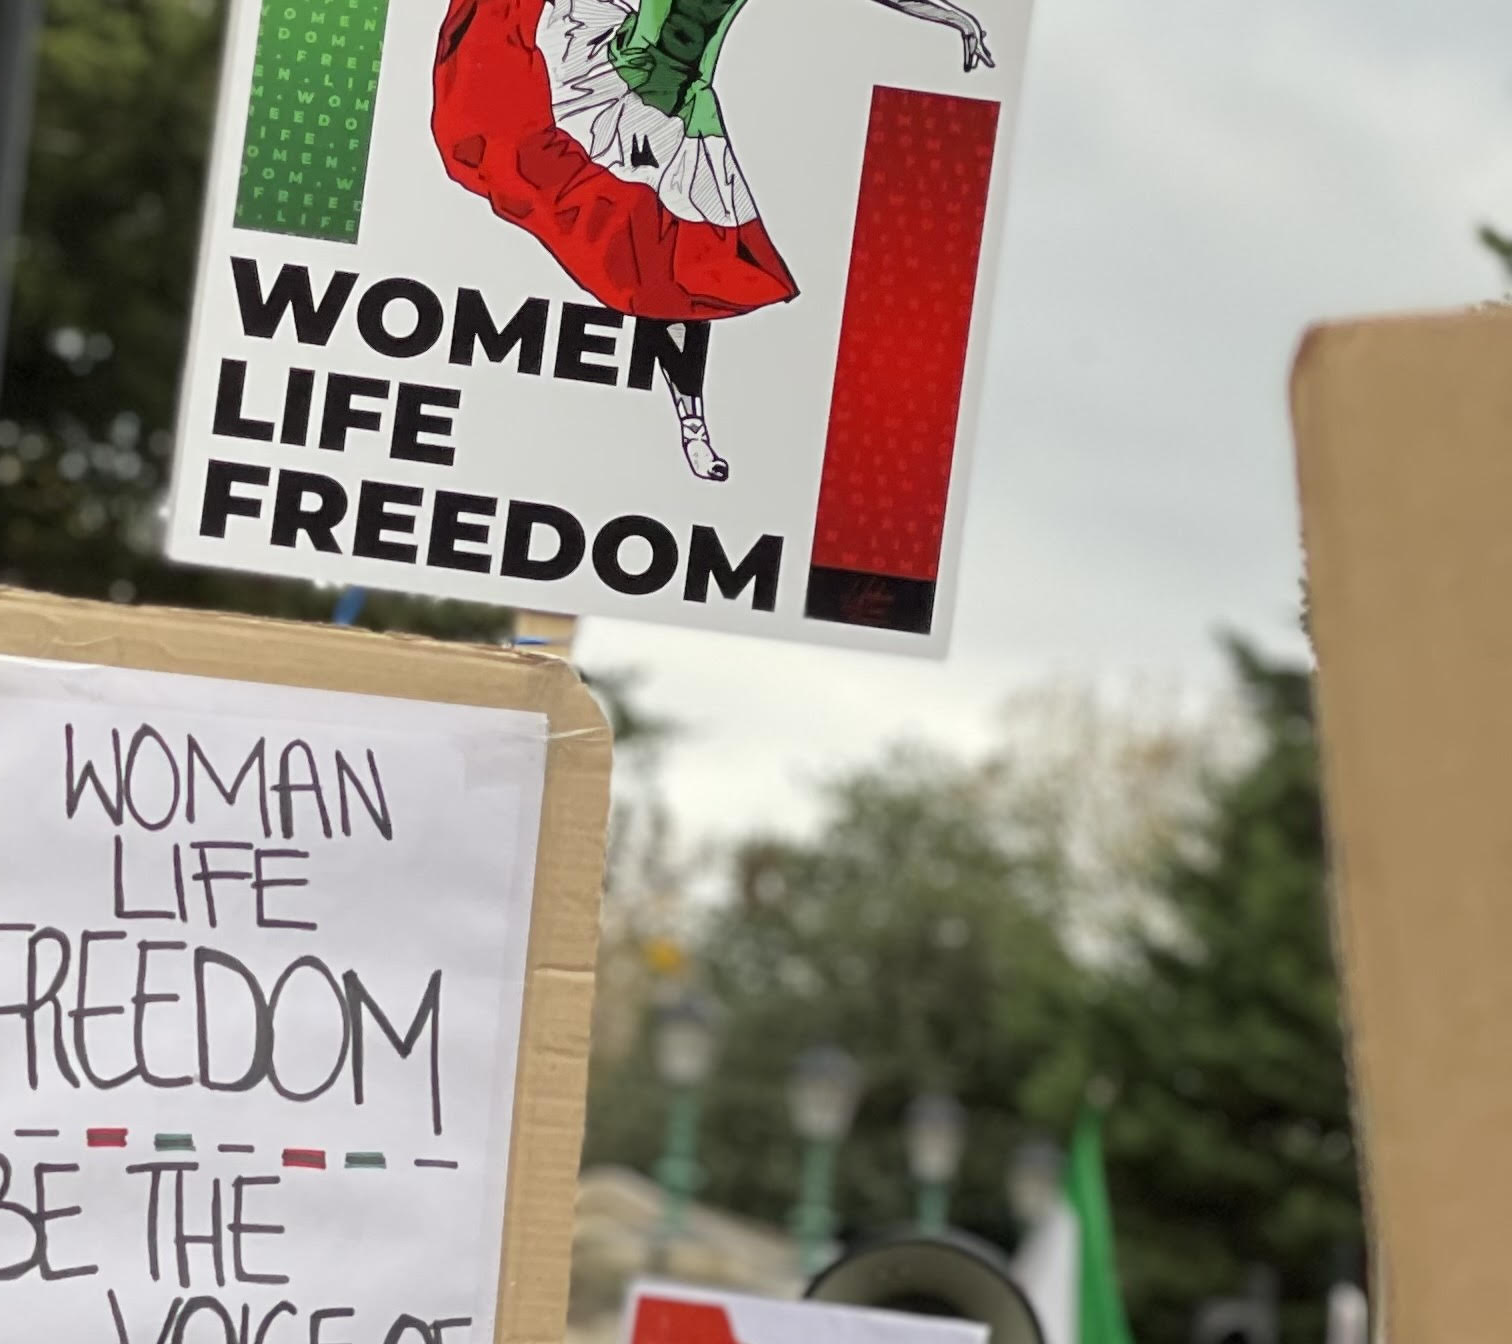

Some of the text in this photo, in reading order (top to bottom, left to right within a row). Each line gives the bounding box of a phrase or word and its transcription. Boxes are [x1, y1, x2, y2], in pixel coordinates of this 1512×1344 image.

[229, 256, 711, 397] WOMEN
[211, 358, 462, 466] LIFE
[198, 459, 784, 612] FREEDOM
[65, 723, 394, 841] WOMAN
[113, 836, 317, 930] LIFE
[126, 1161, 290, 1287] THE
